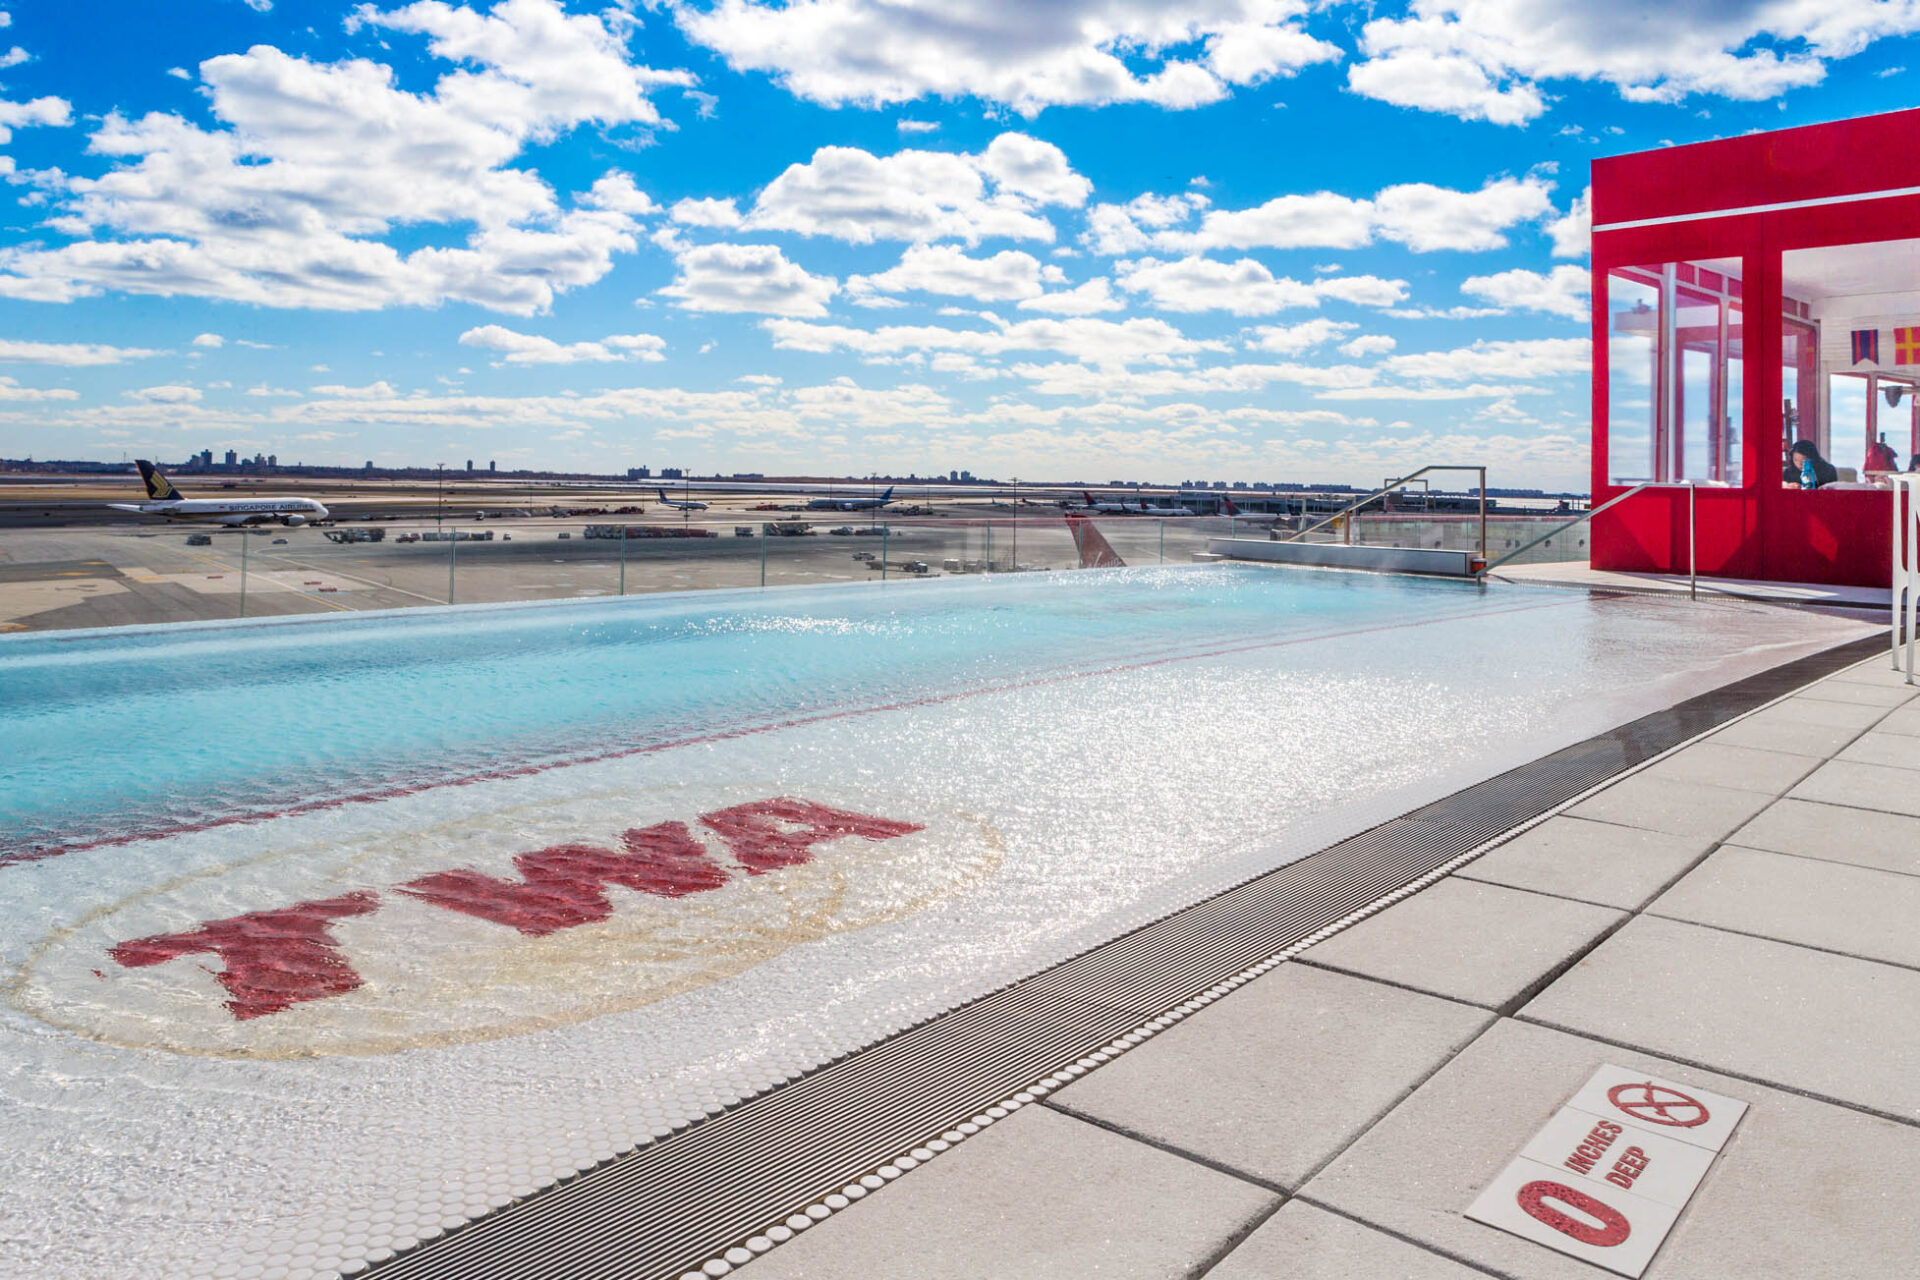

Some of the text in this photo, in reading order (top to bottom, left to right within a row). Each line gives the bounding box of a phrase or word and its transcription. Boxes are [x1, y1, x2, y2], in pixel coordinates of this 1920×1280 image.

[228, 504, 277, 512] SINGAPORE
[105, 797, 926, 1021] TWA
[1563, 1120, 1623, 1175] INCHES
[1605, 1146, 1652, 1190] DEEP
[1516, 1180, 1631, 1247] 0
